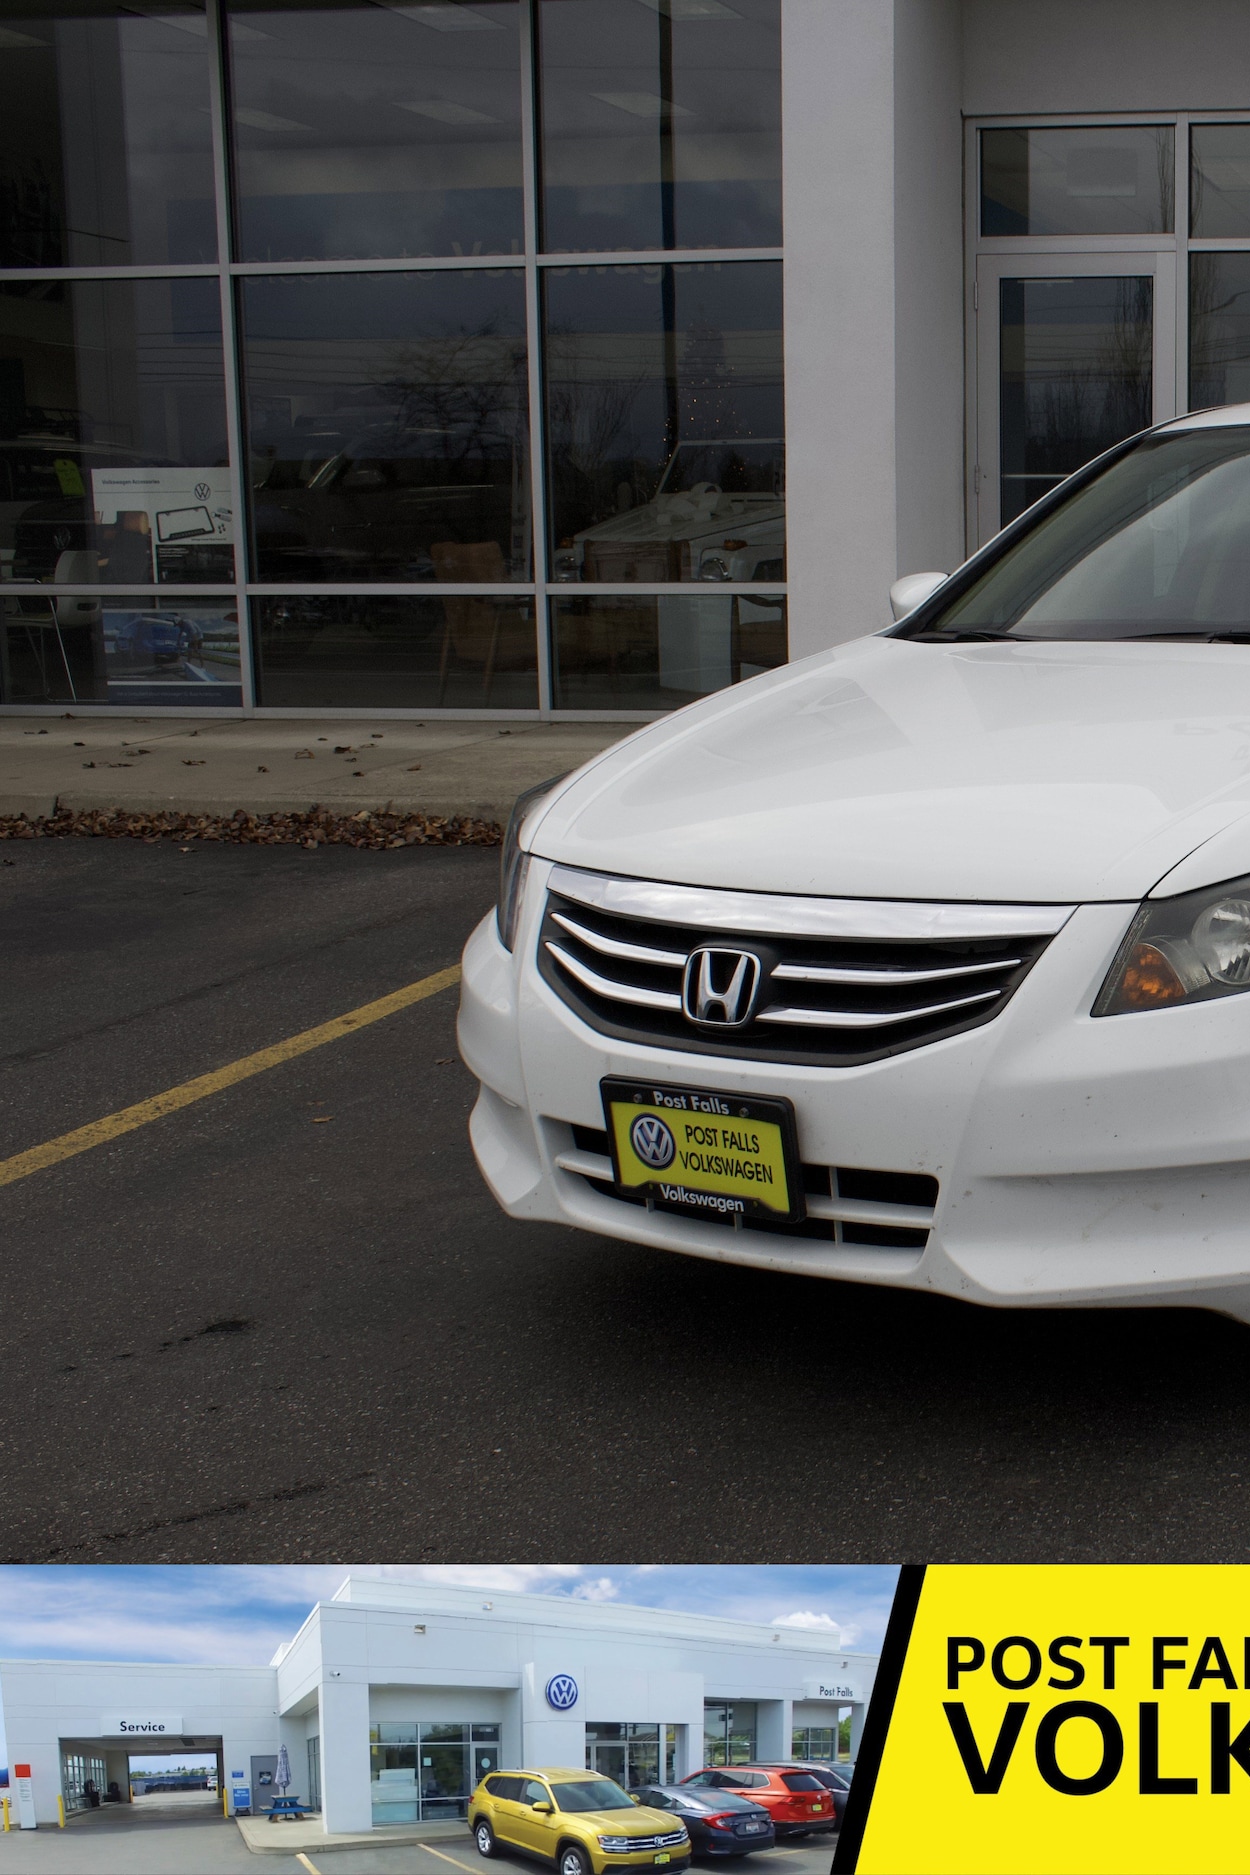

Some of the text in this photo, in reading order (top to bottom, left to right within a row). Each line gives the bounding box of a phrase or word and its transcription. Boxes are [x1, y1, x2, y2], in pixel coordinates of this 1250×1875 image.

[198, 245, 391, 286] elcome
[451, 239, 722, 284] Volswagen
[652, 1091, 730, 1115] Post Falls
[684, 1124, 760, 1154] POST FALLS
[678, 1150, 774, 1185] VOLKSWAGEN
[659, 1183, 745, 1212] Volkswagen
